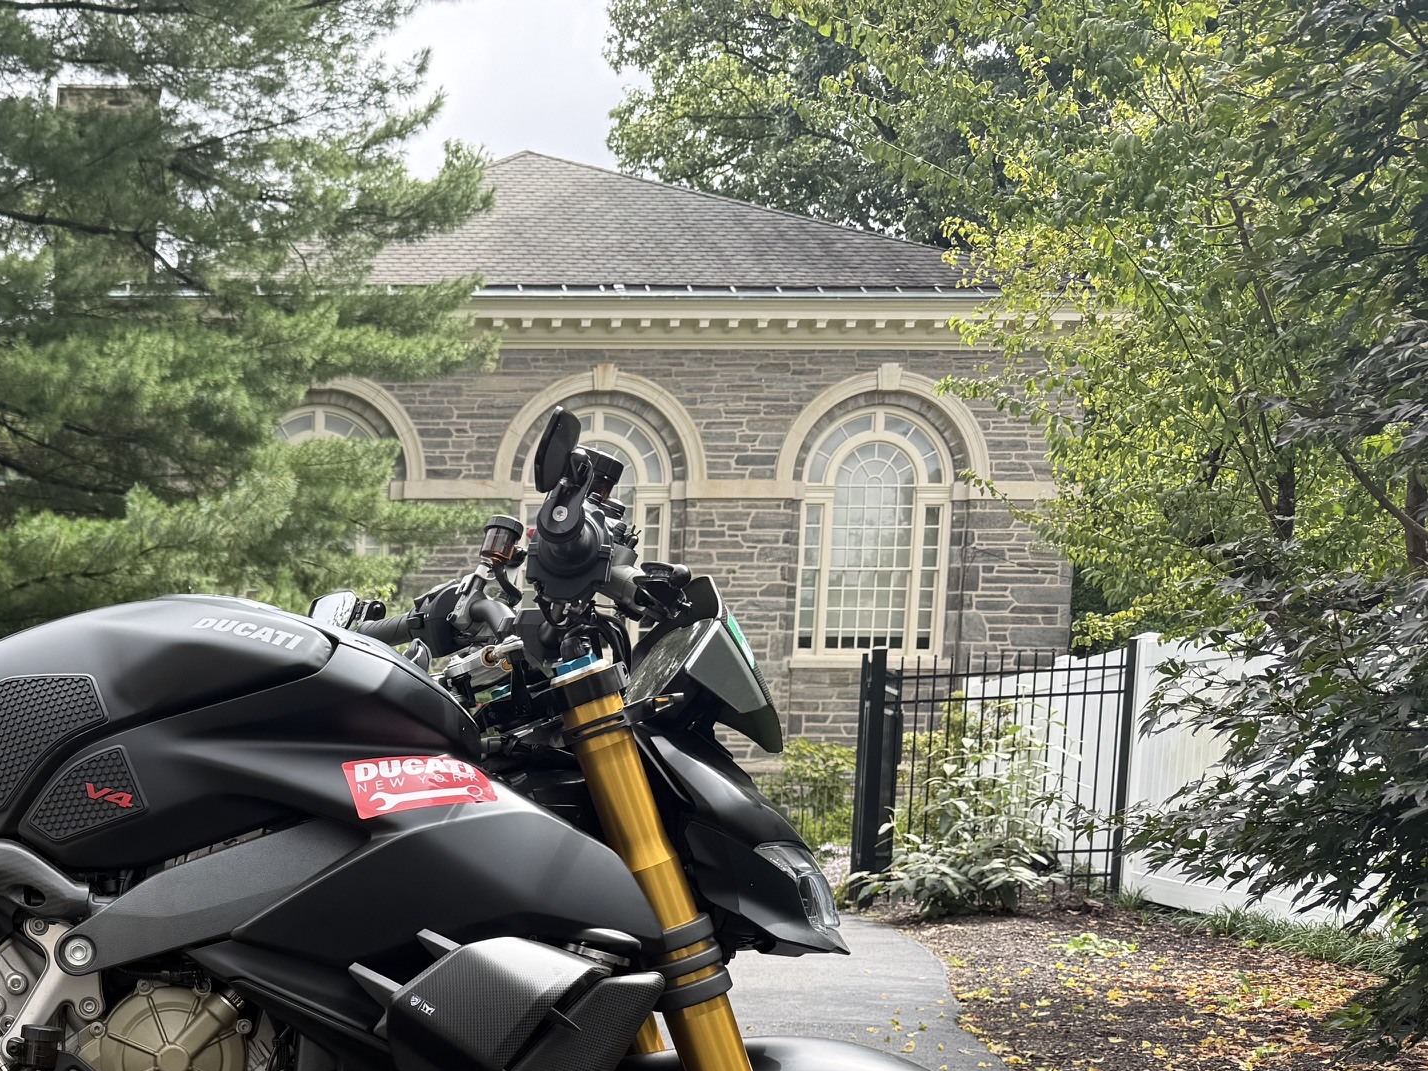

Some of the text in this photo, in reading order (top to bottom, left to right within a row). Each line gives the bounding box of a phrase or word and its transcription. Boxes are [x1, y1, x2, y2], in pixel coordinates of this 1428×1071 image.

[192, 618, 304, 650] DUCATI
[354, 757, 477, 782] DUCATI
[85, 783, 134, 809] V4
[358, 776, 406, 793] NEW
